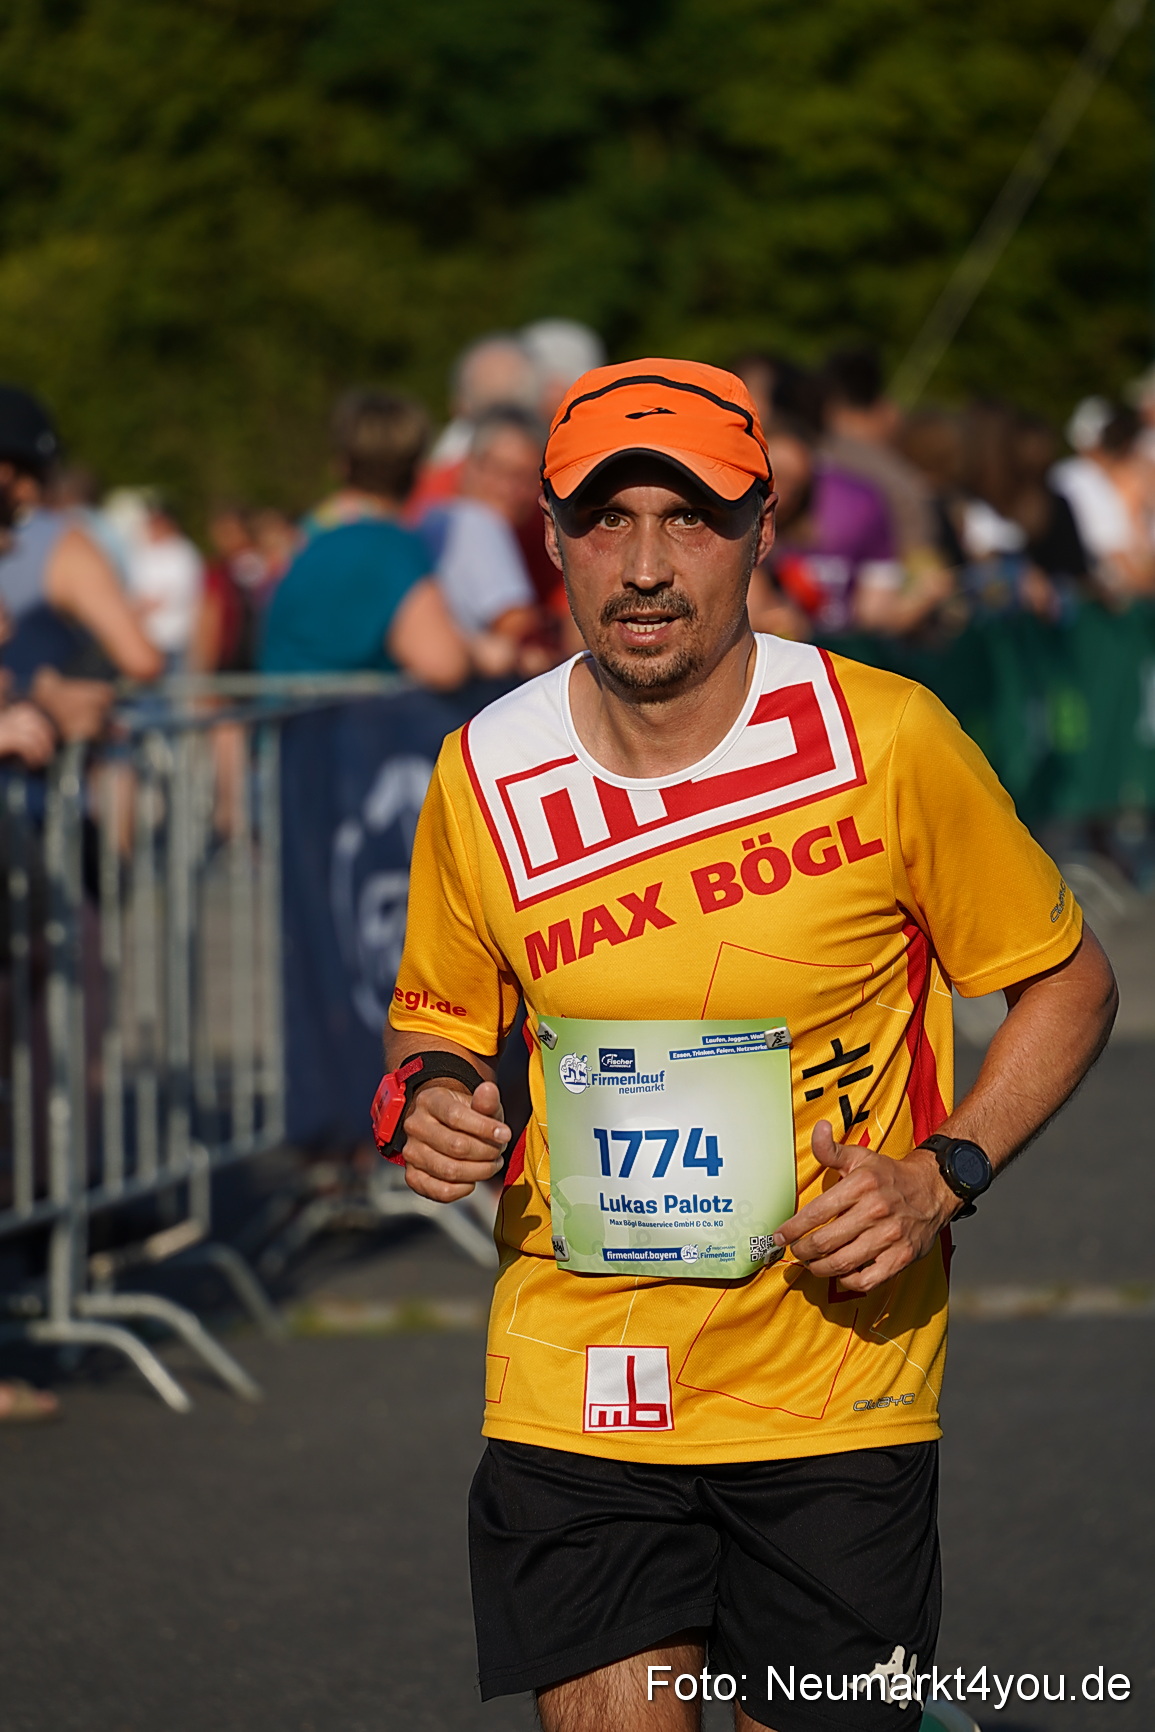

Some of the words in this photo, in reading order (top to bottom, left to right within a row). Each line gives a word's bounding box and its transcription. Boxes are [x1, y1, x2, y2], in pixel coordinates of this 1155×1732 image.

[523, 881, 677, 982] MAX
[690, 815, 885, 915] BÖGL
[705, 1035, 727, 1043] Laufen,
[727, 1034, 750, 1043] Joggen,
[672, 1051, 692, 1059] Essen,
[692, 1049, 715, 1057] Trinken,
[716, 1047, 736, 1055] Feiern,
[591, 1070, 666, 1086] Firmenlauf
[618, 1083, 665, 1095] neumarkt
[593, 1127, 724, 1179] 1774
[599, 1192, 658, 1215] Lukas
[663, 1193, 734, 1214] Palotz
[609, 1218, 623, 1226] Max
[623, 1219, 637, 1229] Bögl
[637, 1220, 673, 1228] Bauservice
[606, 1250, 678, 1261] firmenlauf.bayern
[699, 1251, 736, 1260] Firmenlauf
